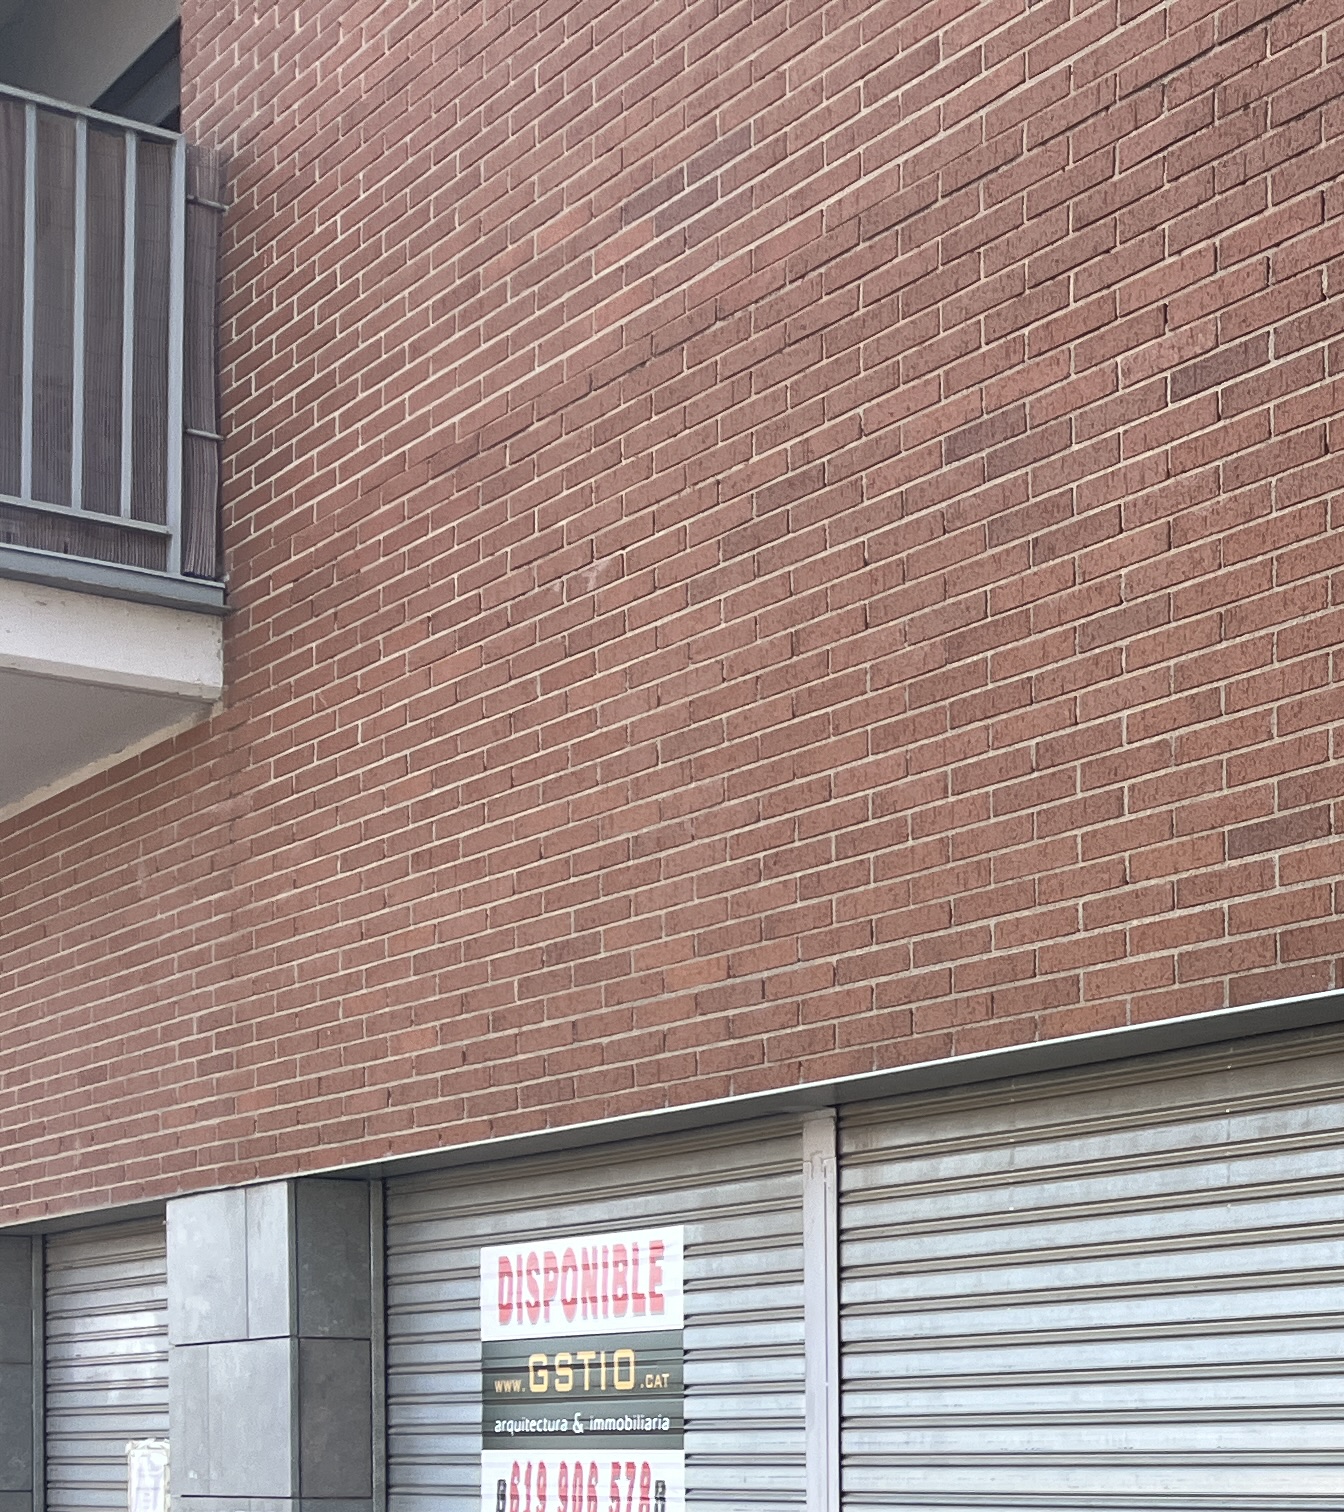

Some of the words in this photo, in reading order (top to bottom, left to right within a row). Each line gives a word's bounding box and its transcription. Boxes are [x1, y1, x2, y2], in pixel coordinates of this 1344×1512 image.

[498, 1240, 665, 1325] DISPONIBLE
[494, 1416, 568, 1436] arquitectura
[572, 1412, 585, 1433] &
[589, 1414, 670, 1431] immobiliaria
